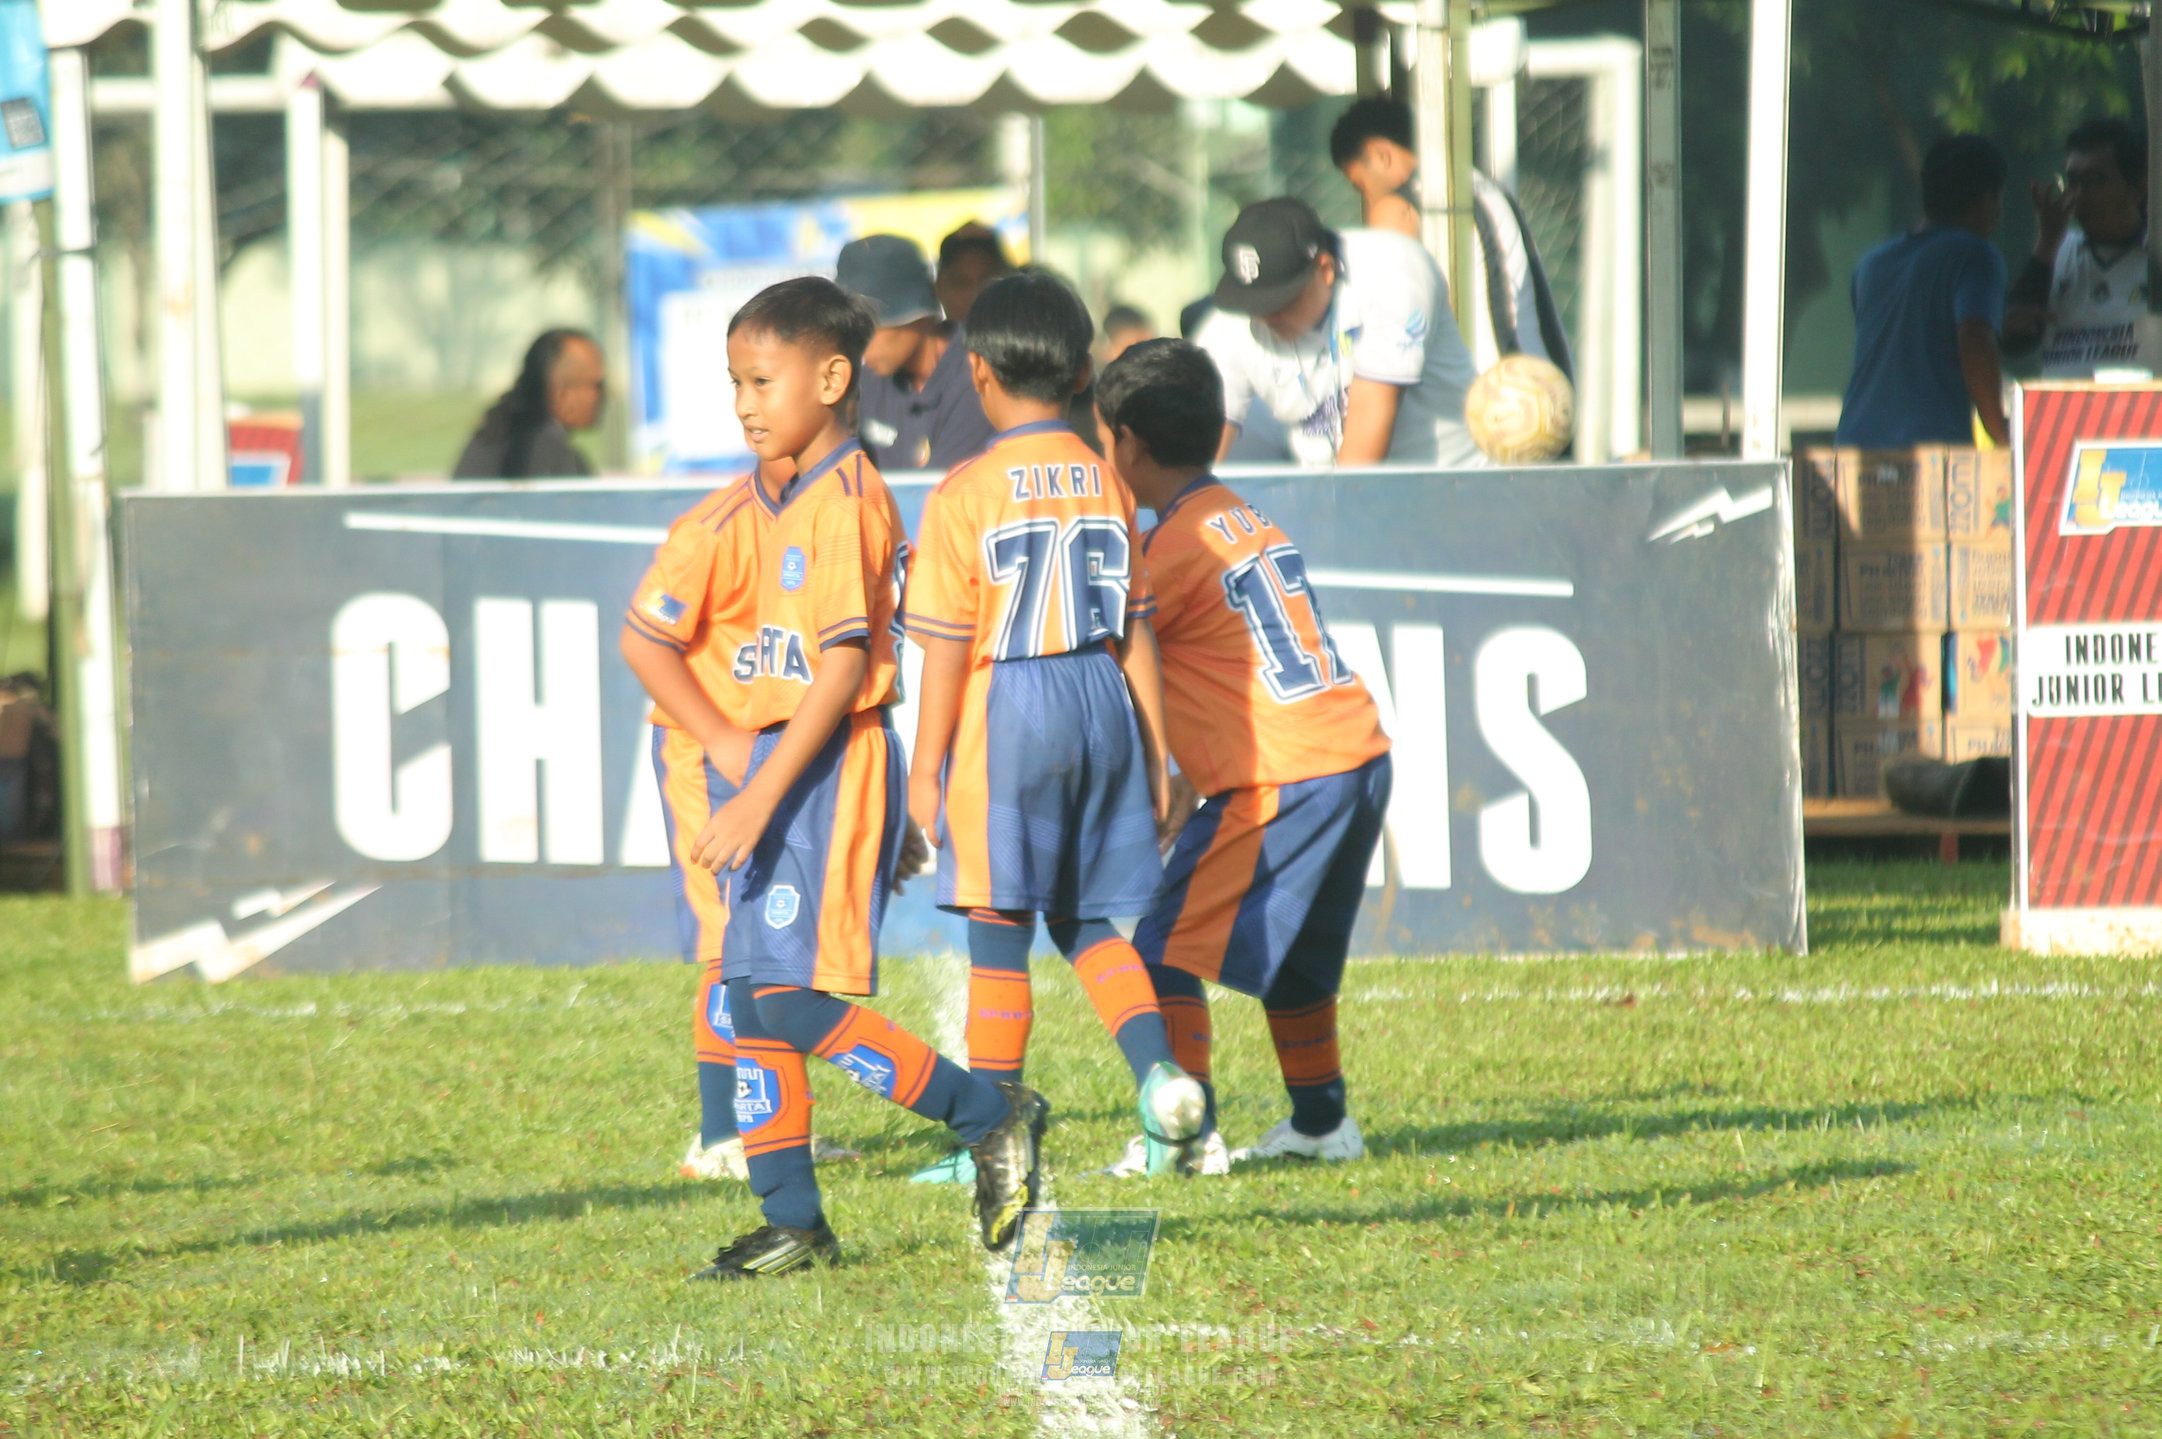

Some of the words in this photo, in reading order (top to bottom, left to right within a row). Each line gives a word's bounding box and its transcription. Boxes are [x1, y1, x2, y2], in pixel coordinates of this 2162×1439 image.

[1008, 464, 1101, 503] ZIKRI
[982, 515, 1130, 662] 76
[1221, 543, 1356, 704] 17
[2031, 672, 2125, 707] JUNIOR
